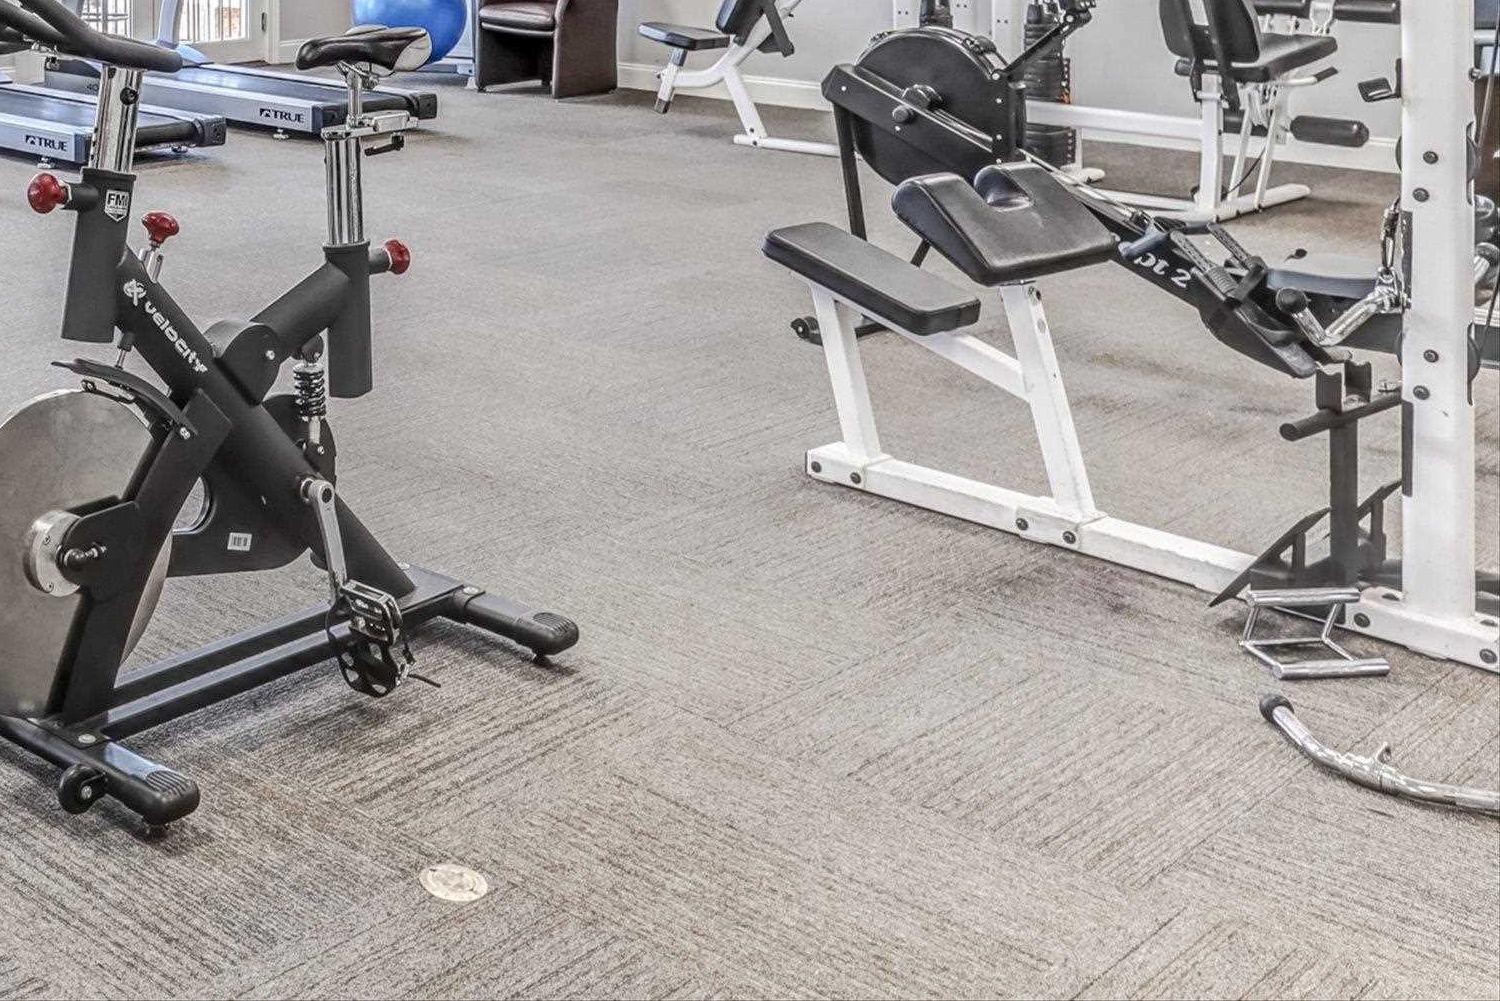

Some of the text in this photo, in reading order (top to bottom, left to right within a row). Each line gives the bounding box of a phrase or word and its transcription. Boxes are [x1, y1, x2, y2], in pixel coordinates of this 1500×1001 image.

[271, 110, 304, 124] TRUE
[35, 136, 68, 152] TRUE
[1171, 268, 1191, 288] 2
